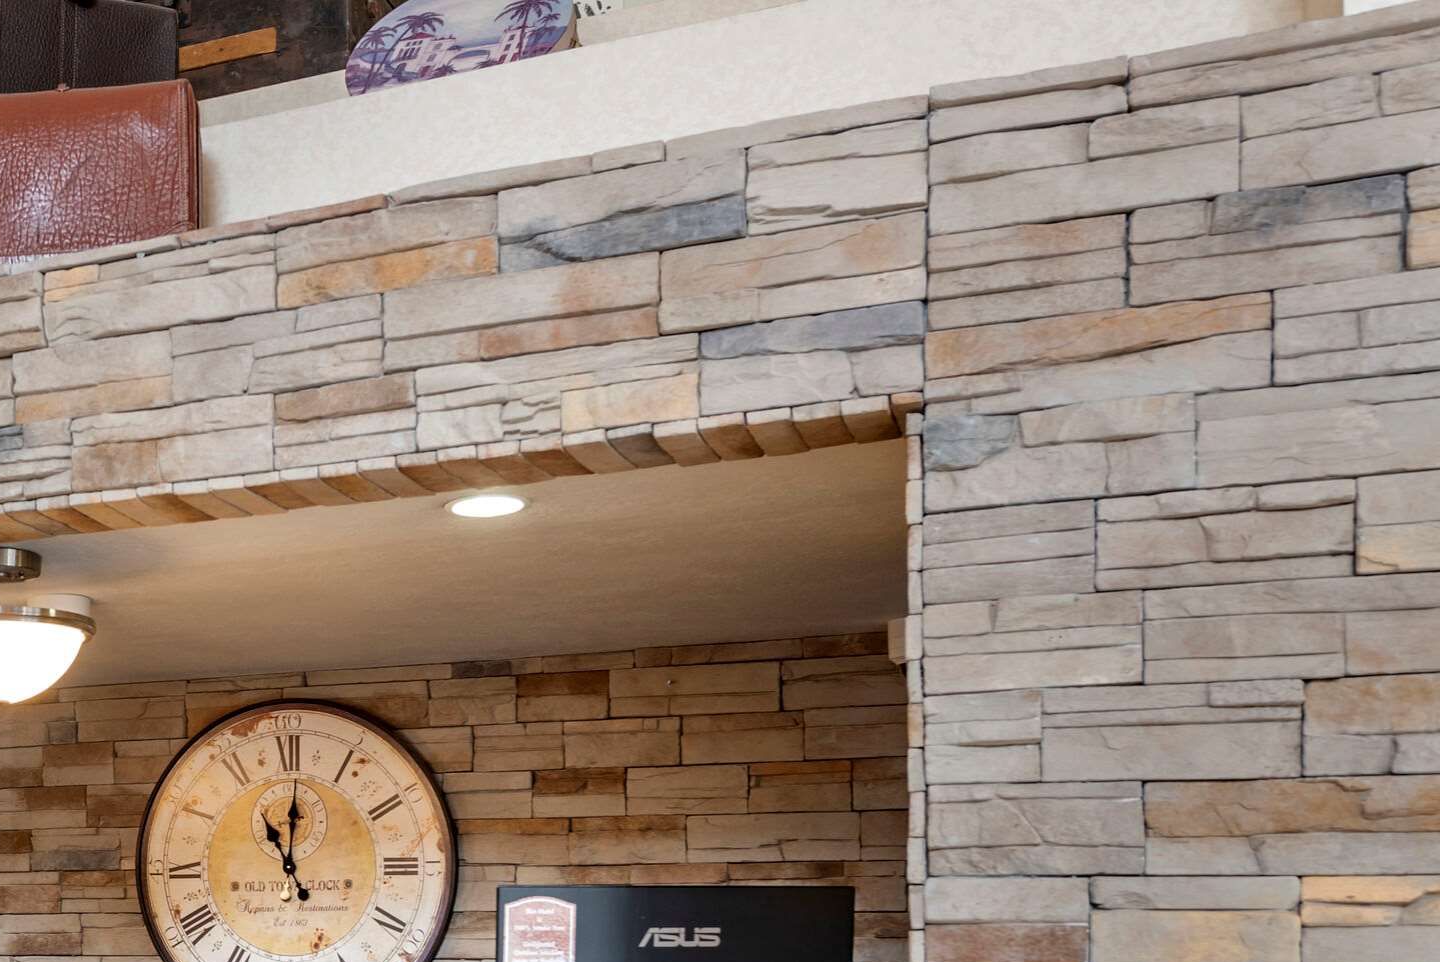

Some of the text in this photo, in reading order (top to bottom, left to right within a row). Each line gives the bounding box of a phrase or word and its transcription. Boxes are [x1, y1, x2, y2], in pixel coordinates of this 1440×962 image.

[244, 879, 341, 893] OLD TO CLOCK
[638, 927, 722, 948] ASUS
